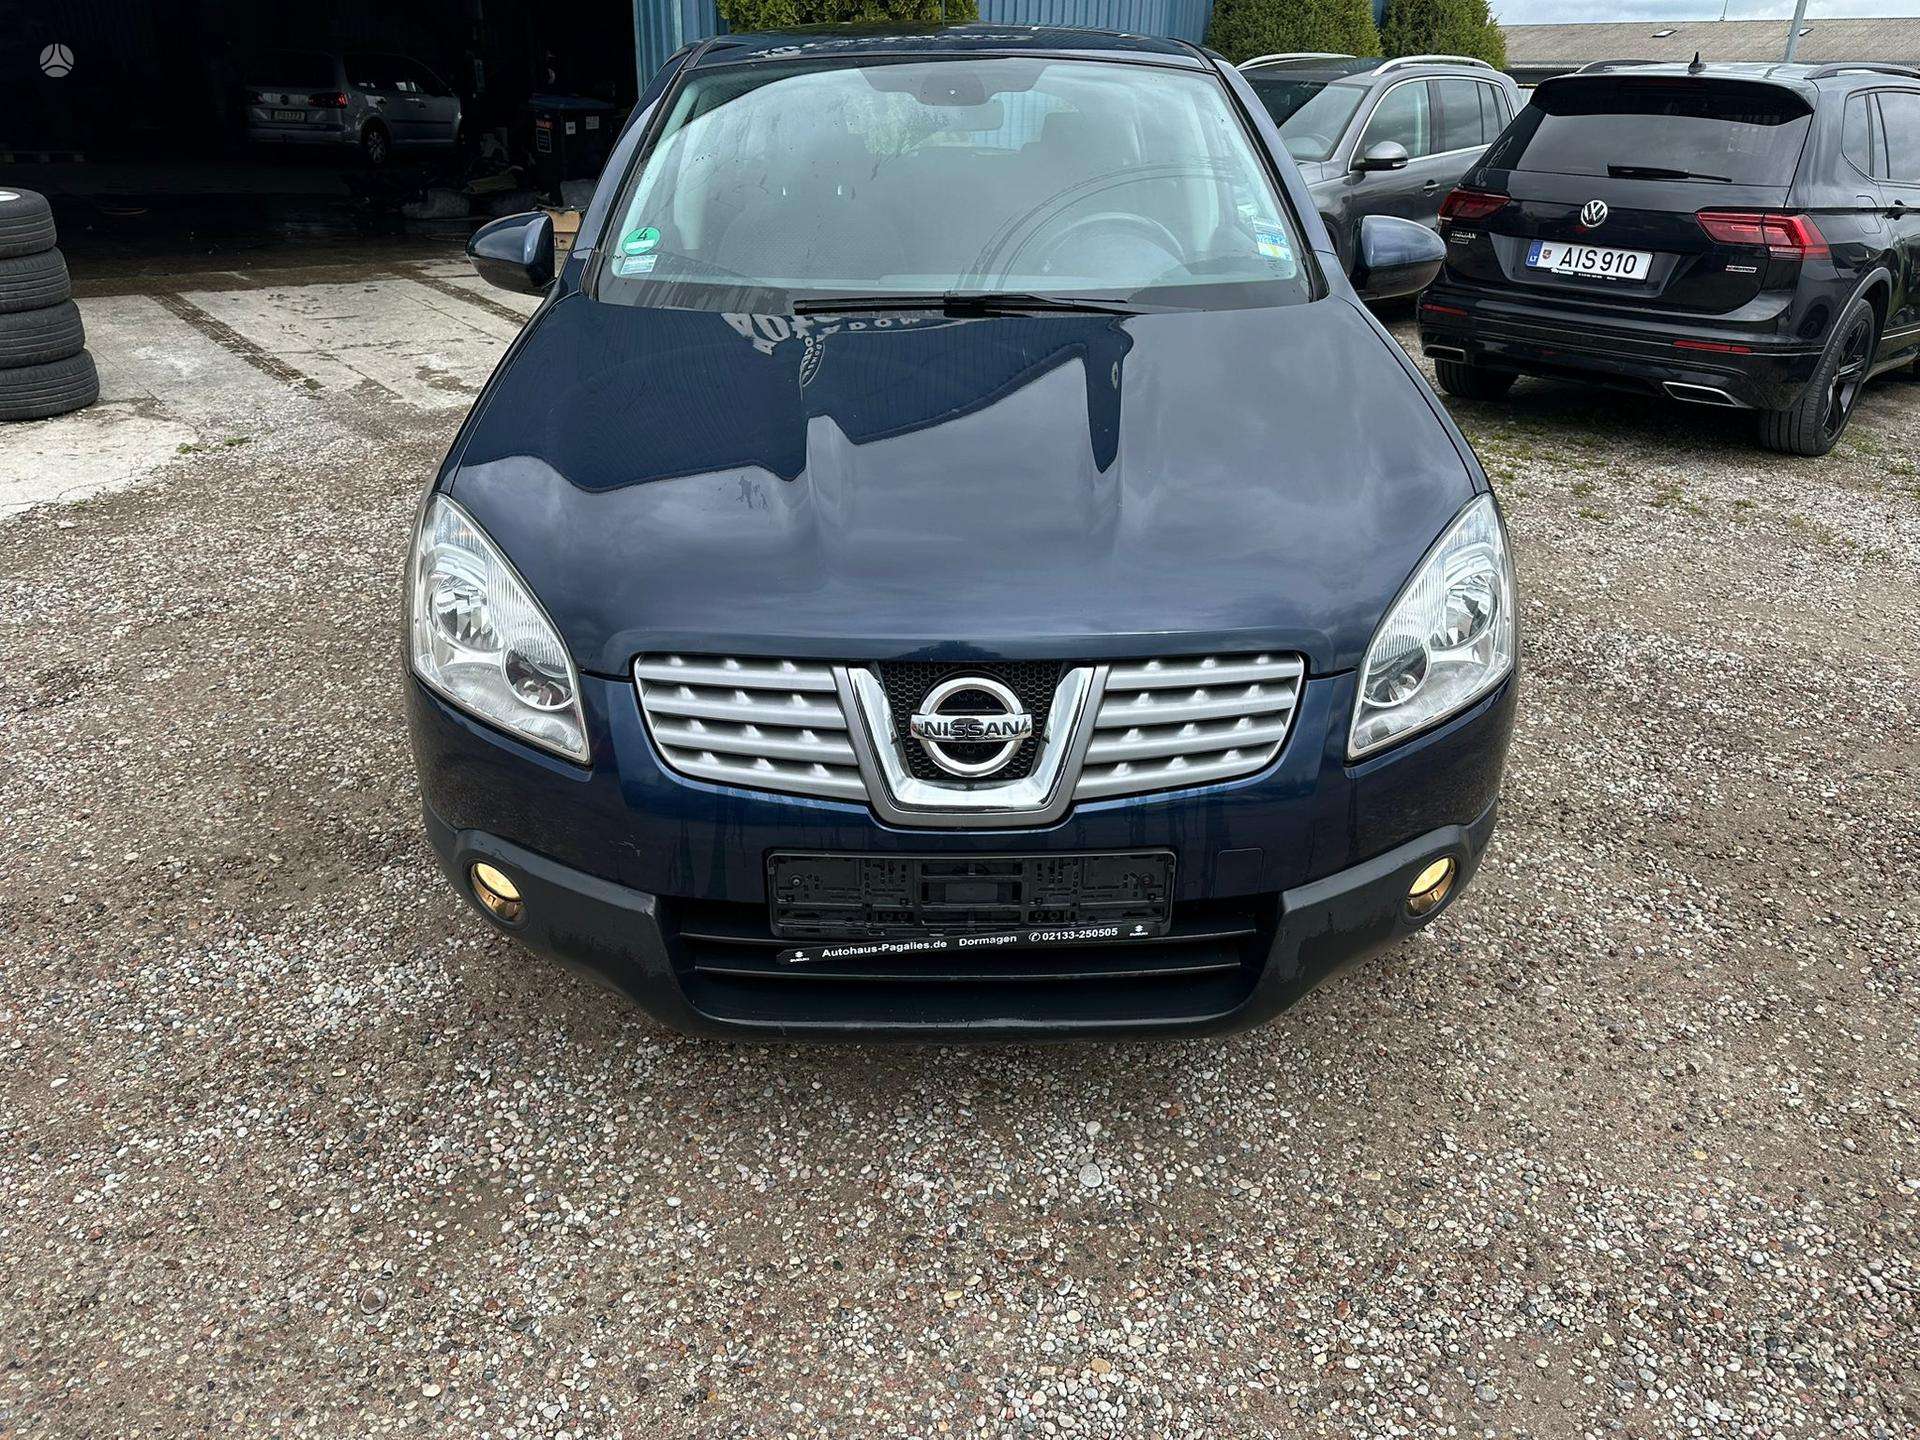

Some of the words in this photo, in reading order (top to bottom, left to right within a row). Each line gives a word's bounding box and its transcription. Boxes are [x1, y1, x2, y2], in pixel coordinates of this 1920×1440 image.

[637, 228, 648, 240] 4
[1559, 247, 1598, 270] AIS
[1600, 251, 1638, 275] 910
[923, 720, 1020, 738] NISSAN
[958, 935, 1018, 947] Dormagen
[1042, 927, 1119, 941] 02133-250505
